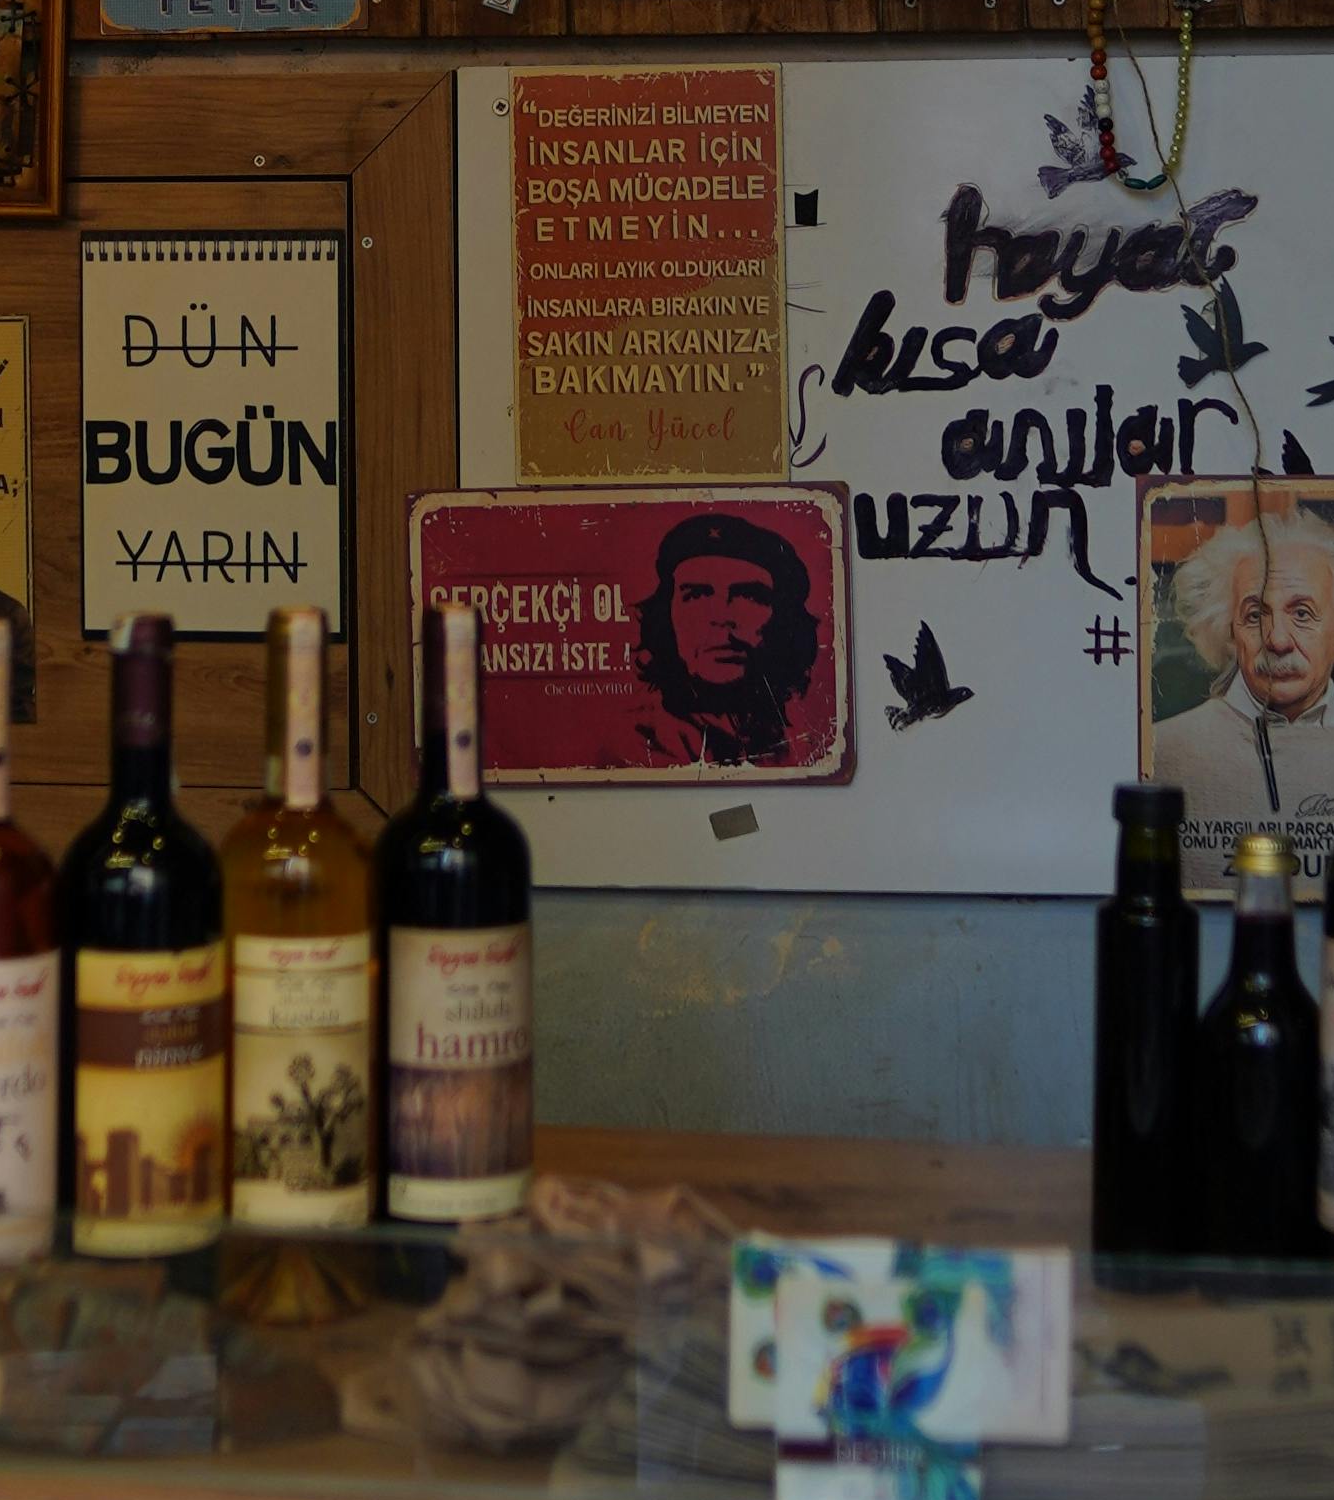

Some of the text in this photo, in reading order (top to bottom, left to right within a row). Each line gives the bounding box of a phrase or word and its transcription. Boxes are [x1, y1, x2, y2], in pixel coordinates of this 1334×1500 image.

[661, 101, 770, 126] BİLMEYEN
[526, 131, 763, 168] İNSANLAR İÇİN
[526, 173, 766, 208] BOŞA MÜCADELE
[534, 208, 760, 243] ETMEYİN...
[529, 257, 767, 281] ONLARI LAYIK OLDUKLARI
[527, 294, 770, 318] İNSANLARA BIRAKIN VE
[125, 303, 277, 369] DÜN
[526, 327, 771, 357] SAKIN ARKANIZA
[831, 290, 1059, 397] kısa
[532, 362, 765, 395] BAKMAYIN."
[85, 404, 338, 487] BUGÜN
[648, 406, 736, 451] Yücel
[941, 385, 1239, 487] anılar
[117, 529, 300, 584] YARIN
[593, 582, 631, 623] OL
